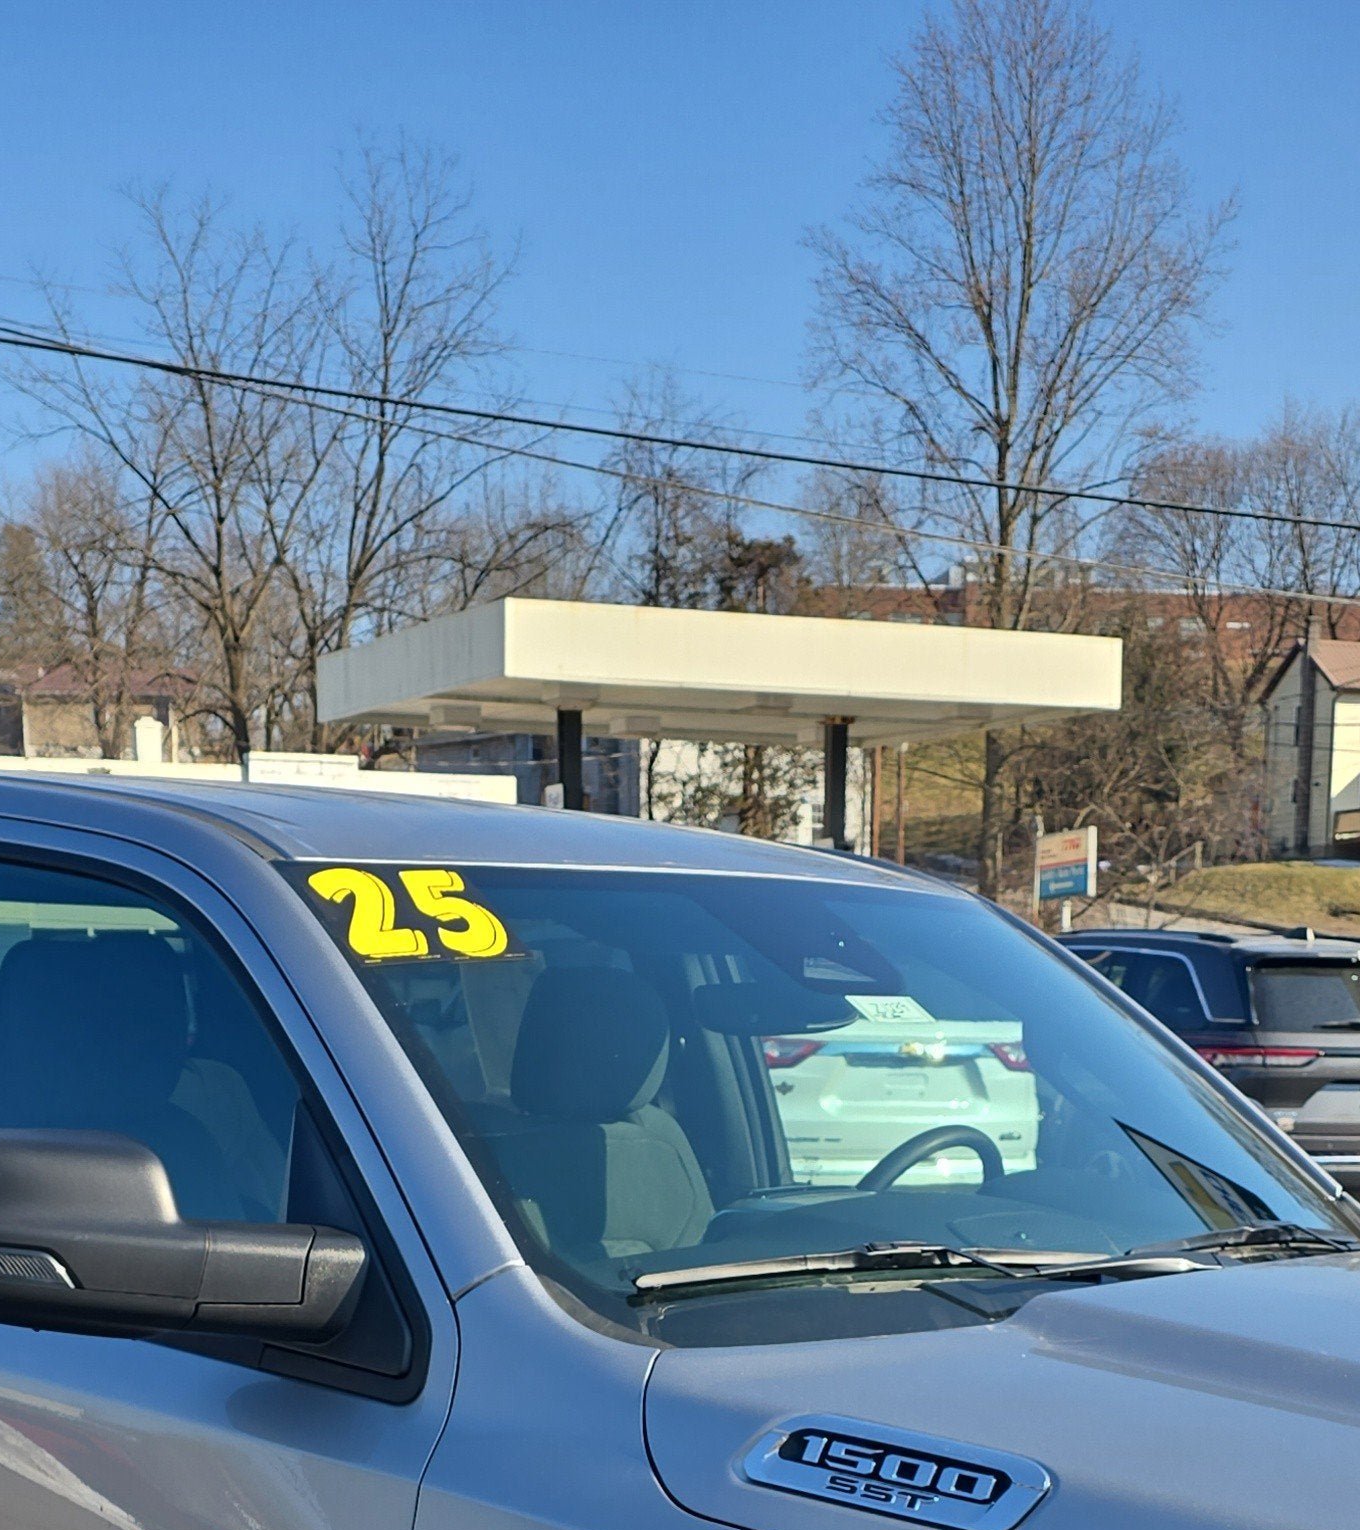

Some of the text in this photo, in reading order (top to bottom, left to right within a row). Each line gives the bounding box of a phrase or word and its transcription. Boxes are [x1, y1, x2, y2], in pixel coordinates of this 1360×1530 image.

[307, 867, 508, 958] 25
[801, 1434, 997, 1502] 1500
[825, 1475, 940, 1512] SST
